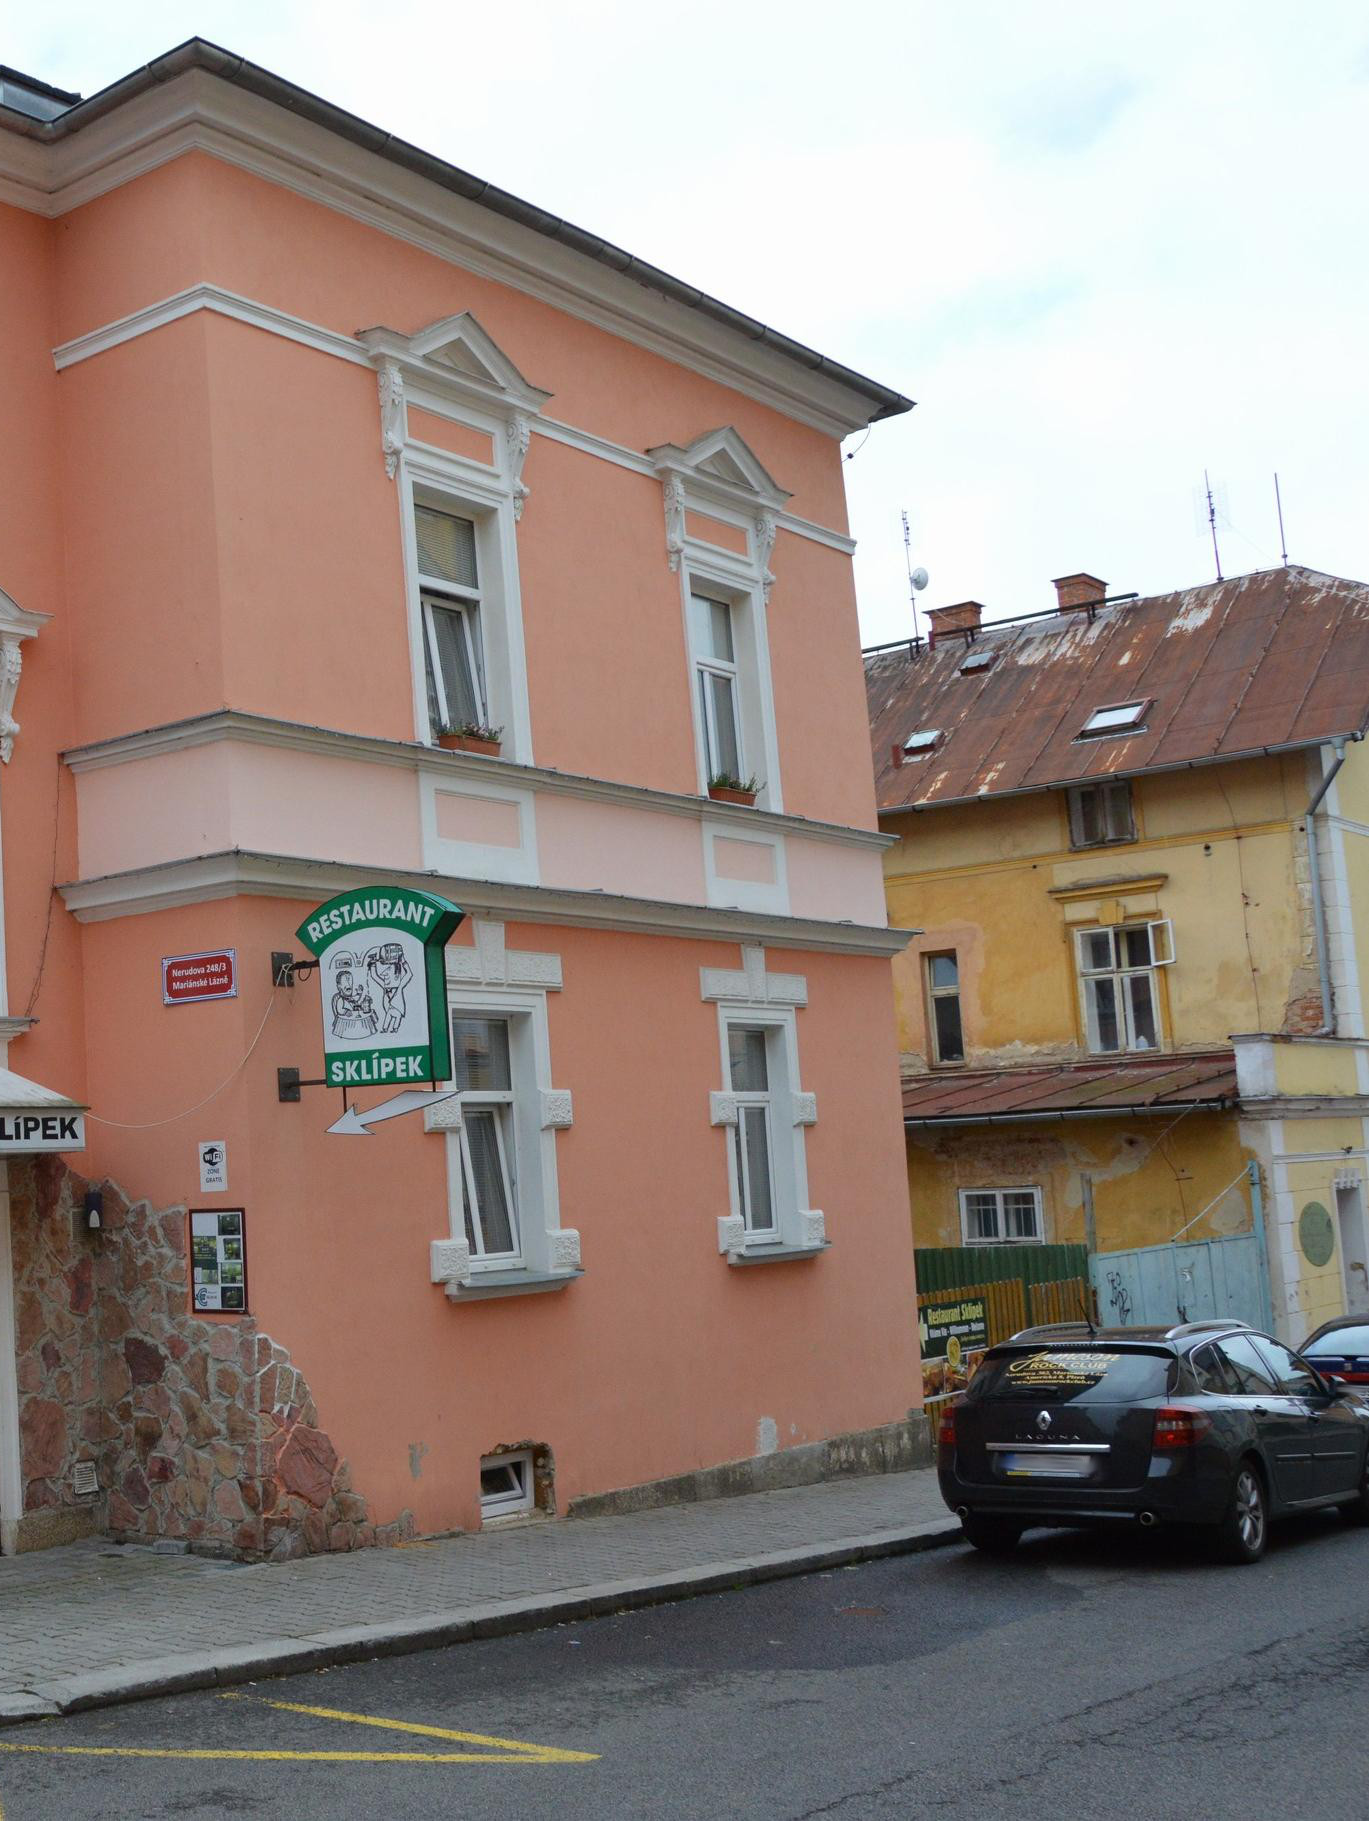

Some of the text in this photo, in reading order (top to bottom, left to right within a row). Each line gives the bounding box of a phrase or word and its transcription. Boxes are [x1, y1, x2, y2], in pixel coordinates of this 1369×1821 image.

[306, 899, 435, 943] RESTAURANT
[172, 962, 227, 977] Nerudova 248/3
[172, 975, 229, 990] Mariánské Lázně
[332, 1051, 424, 1082] SKLÍPEK
[1030, 1361, 1107, 1369] ROCK CLUB
